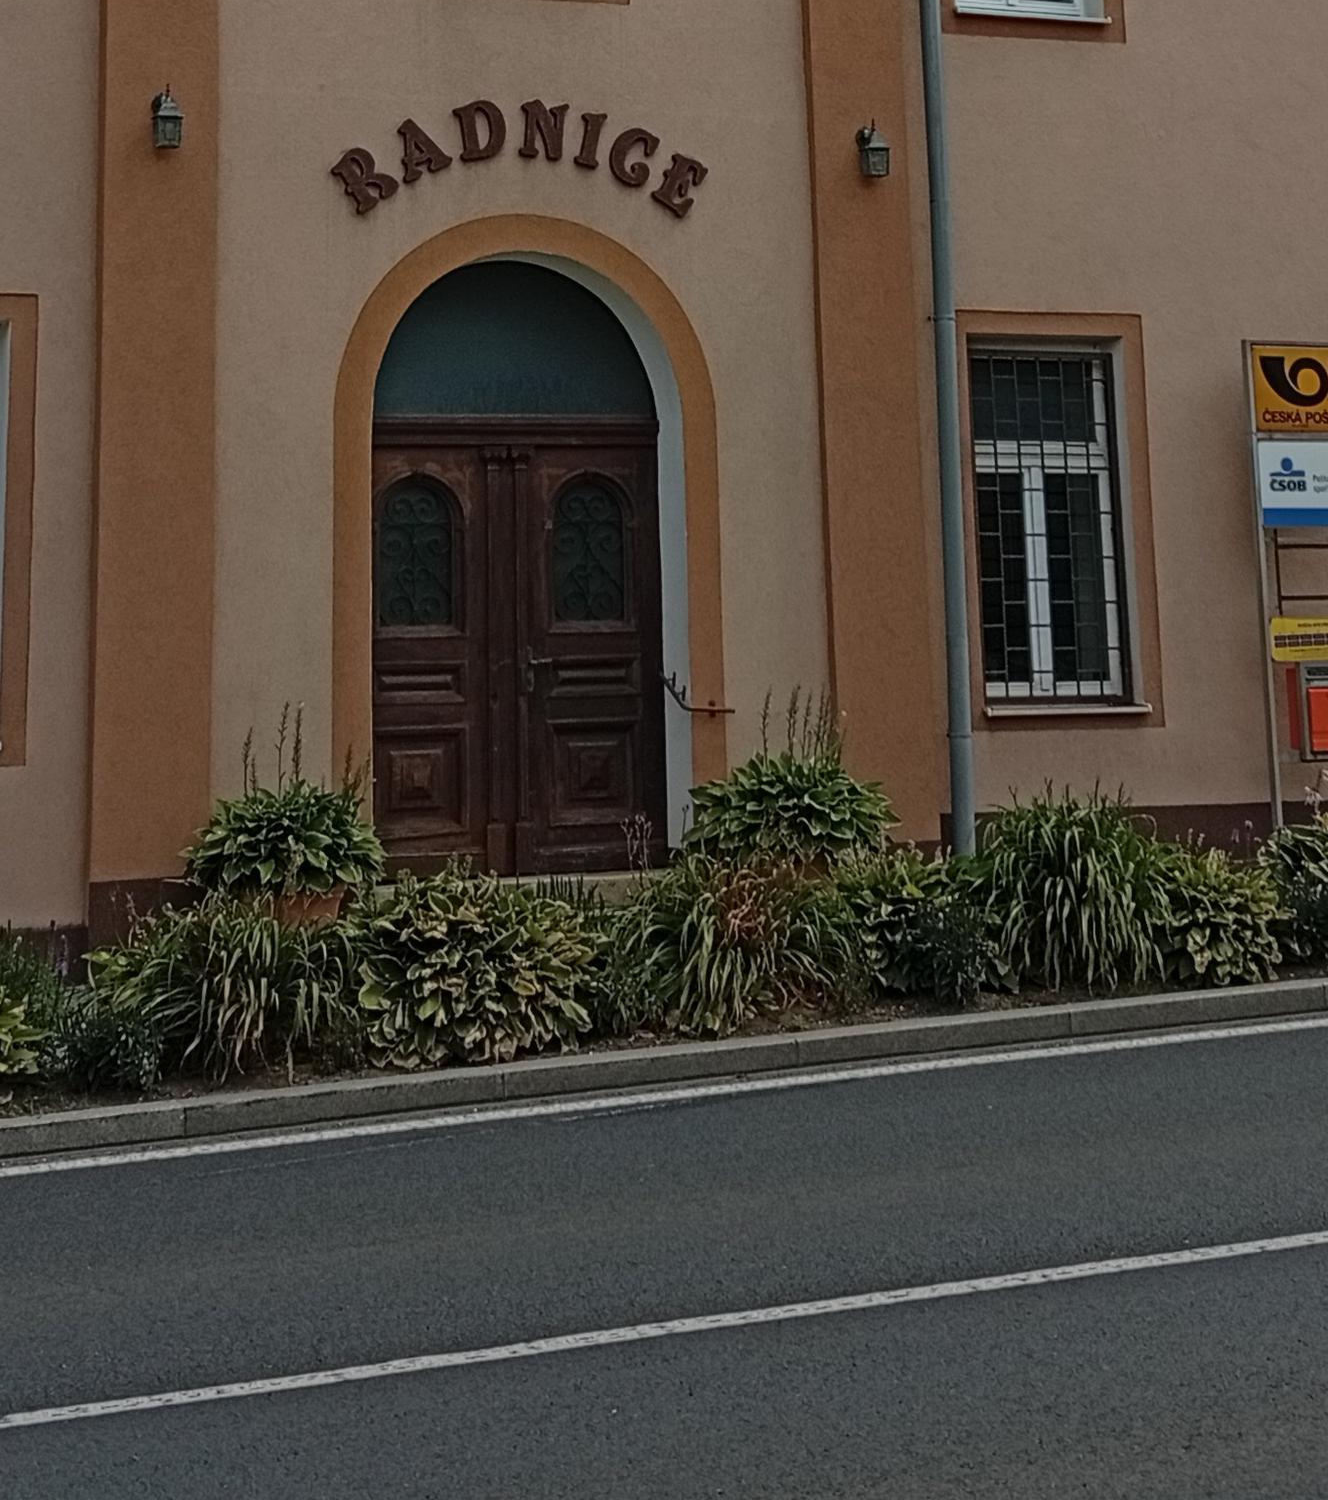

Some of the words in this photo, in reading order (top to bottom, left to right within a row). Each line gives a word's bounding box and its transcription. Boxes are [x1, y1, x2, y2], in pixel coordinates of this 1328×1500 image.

[331, 99, 708, 218] RADNICE
[1262, 408, 1302, 424] ČESKÁ
[1269, 478, 1307, 492] ČSOB
